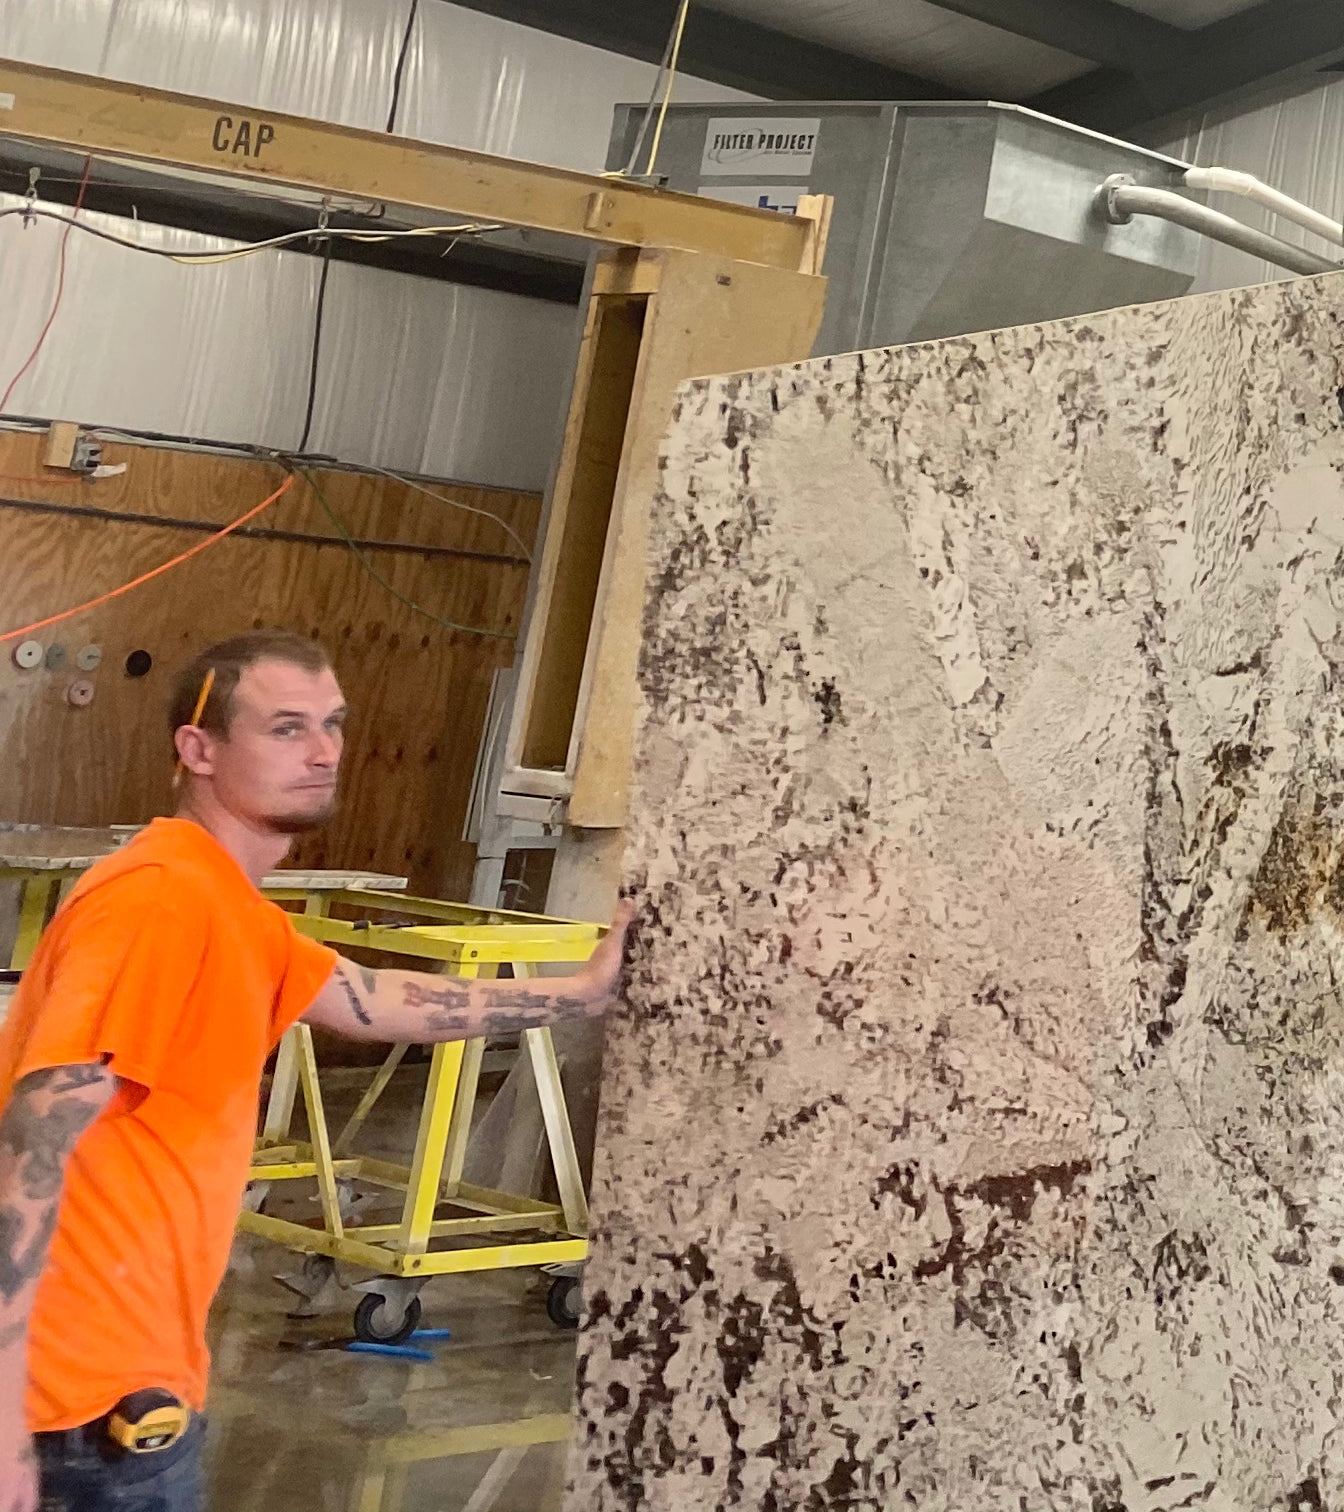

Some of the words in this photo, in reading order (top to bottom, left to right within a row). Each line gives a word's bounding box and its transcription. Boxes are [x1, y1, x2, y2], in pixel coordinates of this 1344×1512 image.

[213, 117, 275, 158] CAP
[713, 134, 754, 150] FILTER
[758, 134, 814, 150] PROJECT
